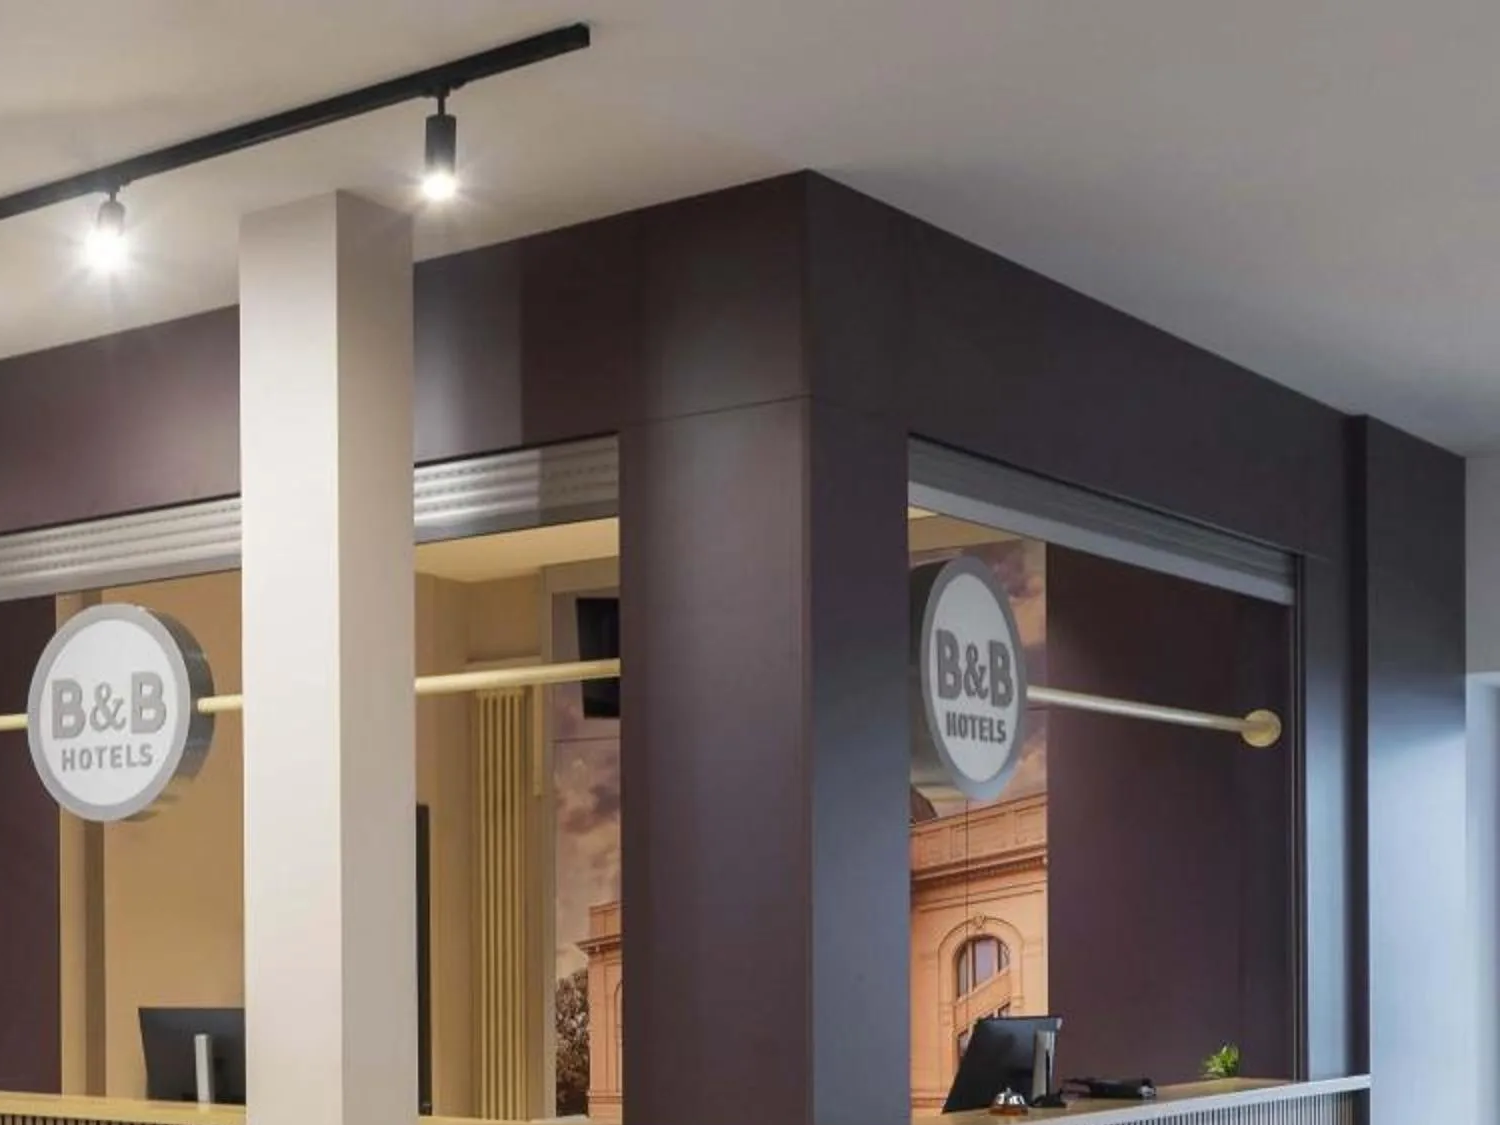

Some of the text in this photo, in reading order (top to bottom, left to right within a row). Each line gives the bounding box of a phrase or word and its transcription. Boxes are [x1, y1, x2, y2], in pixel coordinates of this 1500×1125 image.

[936, 628, 1014, 707] B&B
[51, 672, 167, 739] B&B
[945, 711, 1007, 743] HOTELS
[61, 744, 153, 772] HOTELS
